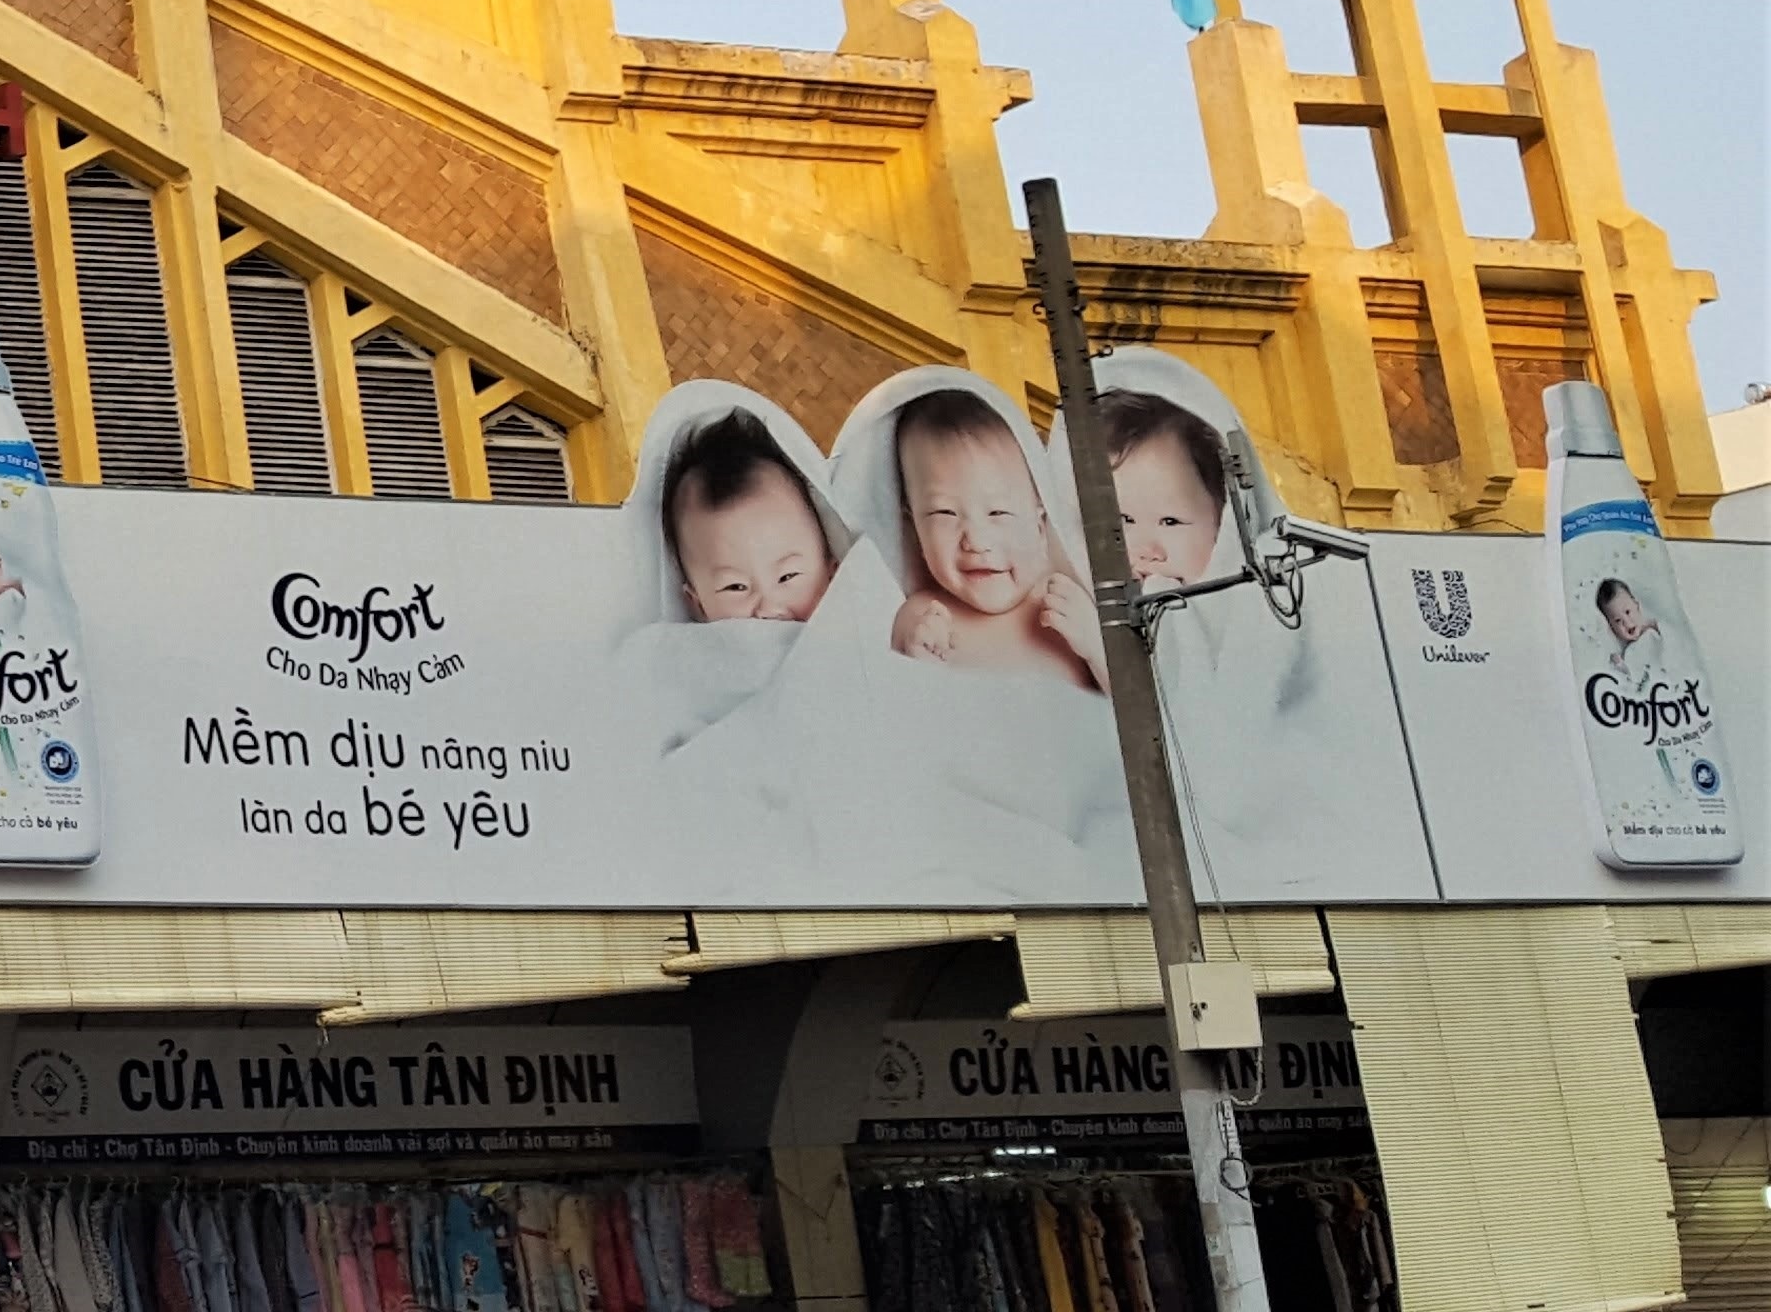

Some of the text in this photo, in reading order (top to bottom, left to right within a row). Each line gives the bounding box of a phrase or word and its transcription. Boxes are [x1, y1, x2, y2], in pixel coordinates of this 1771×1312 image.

[272, 572, 444, 663] Comfort
[266, 646, 466, 695] Cho Da Nhạy Cảm
[1422, 644, 1490, 663] Unilever
[183, 706, 571, 779] Mềm dịu nâng niu
[1585, 673, 1710, 746] Comfort
[240, 785, 529, 850] làn da bé yêu
[119, 1039, 223, 1111] CỬA
[239, 1043, 378, 1109] HÀNG
[389, 1042, 490, 1106] TÂN
[504, 1054, 620, 1116] ĐỊNH
[950, 1029, 1038, 1096] CỬA
[1052, 1032, 1169, 1095] HÀNG
[142, 1135, 176, 1157] Tân
[238, 1134, 298, 1160] Chuyên
[302, 1133, 339, 1155] kinh
[344, 1133, 393, 1153] doanh
